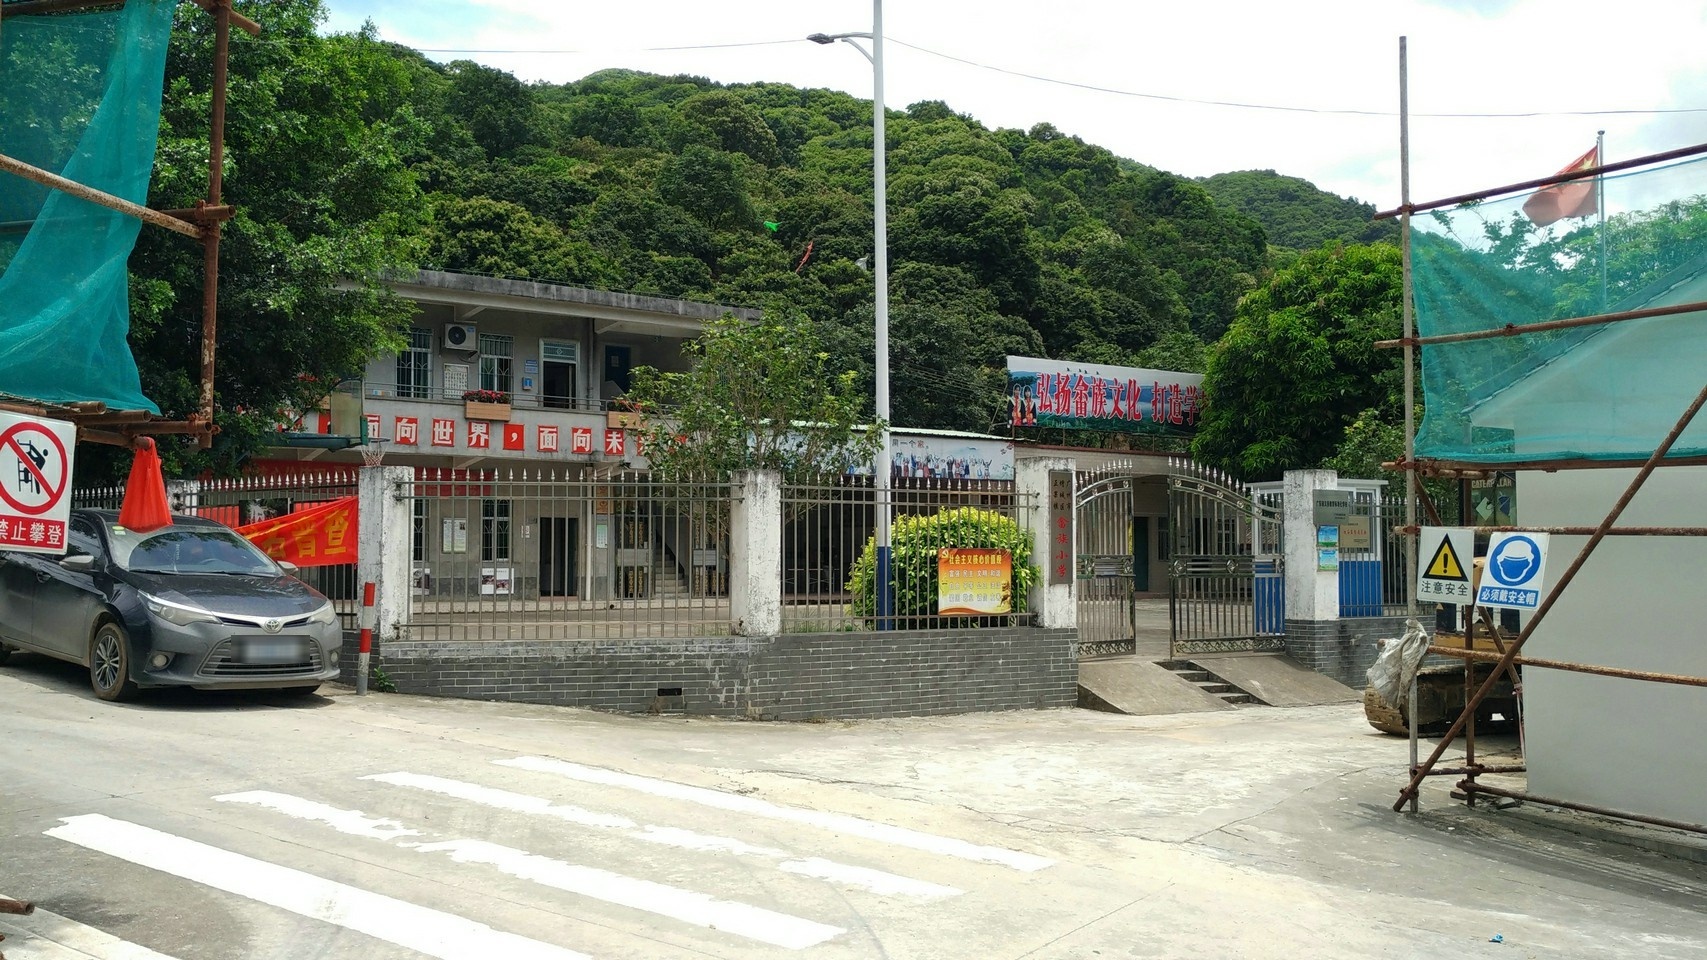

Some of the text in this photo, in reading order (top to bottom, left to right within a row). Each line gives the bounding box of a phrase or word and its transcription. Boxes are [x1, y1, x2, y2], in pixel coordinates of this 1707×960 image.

[1036, 372, 1142, 421] 弘扬畲族文化
[948, 554, 1002, 565] 社会主义核心价值观
[1421, 580, 1468, 597] 注意安全
[1481, 588, 1536, 606] 必须戴安全帽
